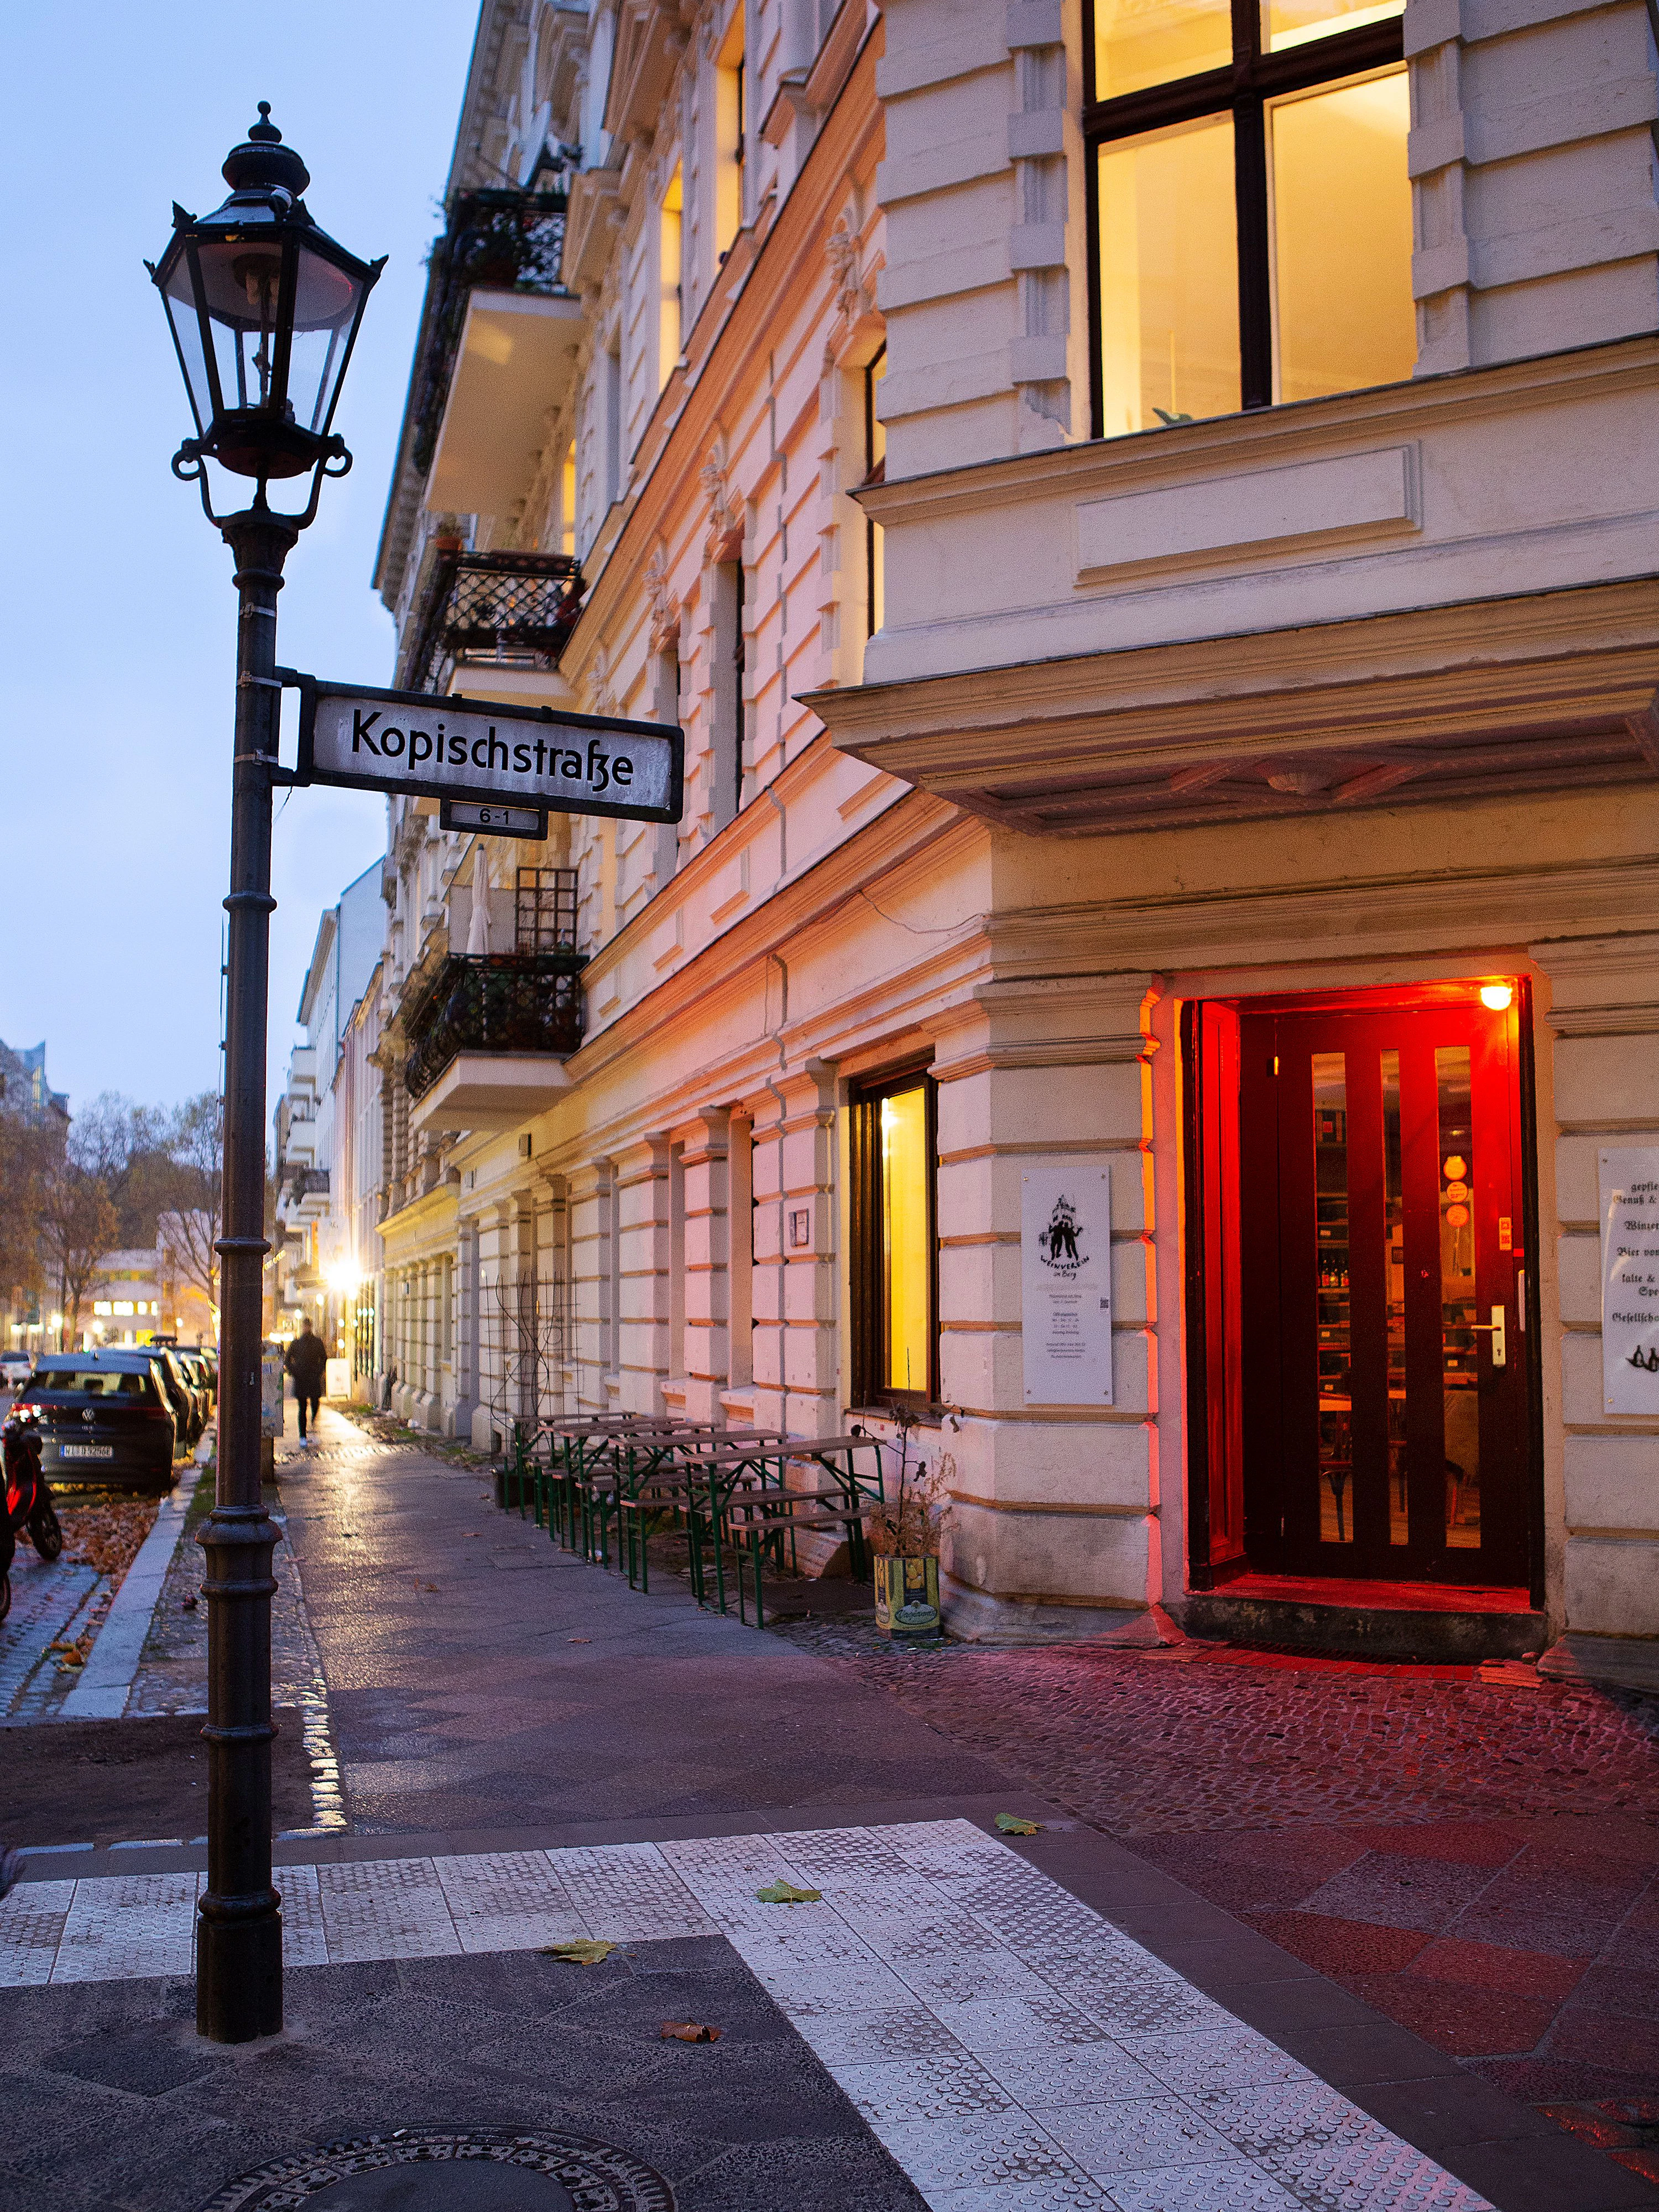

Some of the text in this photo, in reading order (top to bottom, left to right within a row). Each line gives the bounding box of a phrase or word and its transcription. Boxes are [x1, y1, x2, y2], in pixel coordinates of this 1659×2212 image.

[352, 708, 634, 792] Kopischstraße
[479, 808, 510, 826] 6-1
[1648, 1194, 1657, 1204] &
[1041, 1255, 1089, 1269] WEINVEREIN
[1646, 1273, 1655, 1283] &
